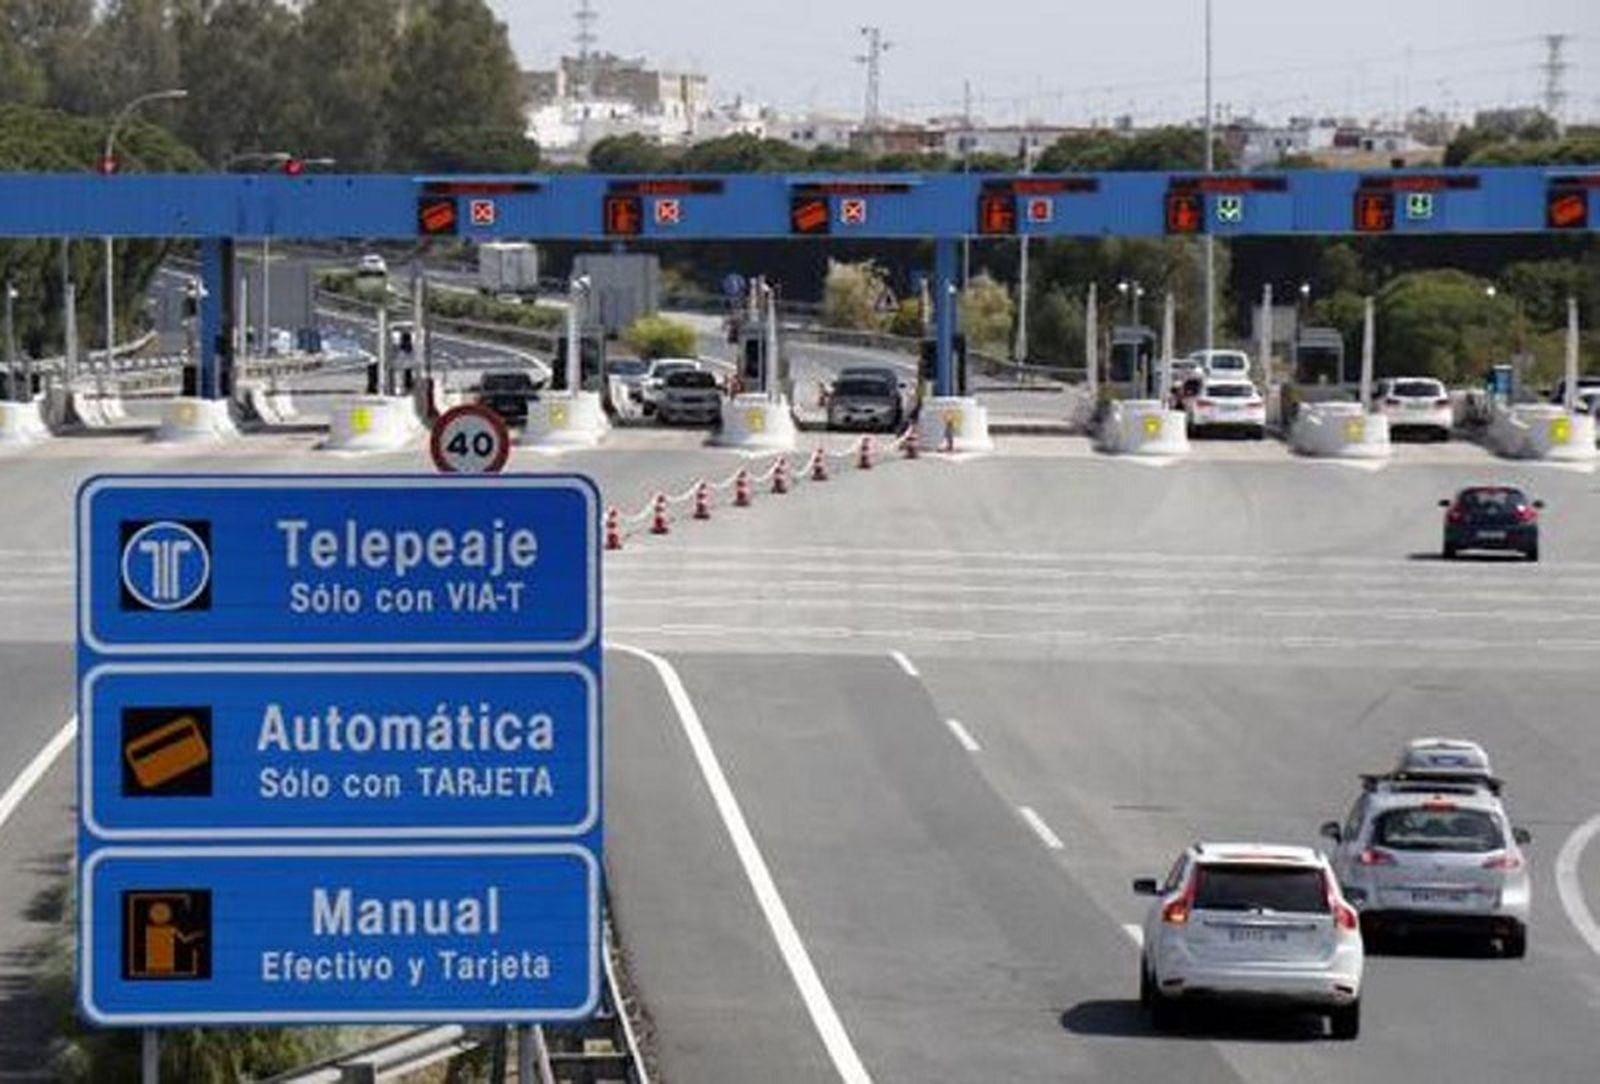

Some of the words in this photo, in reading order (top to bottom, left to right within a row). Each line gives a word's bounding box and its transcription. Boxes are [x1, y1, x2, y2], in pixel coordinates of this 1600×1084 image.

[446, 430, 494, 459] 40
[279, 520, 538, 576] Telepeaje
[291, 582, 361, 613] Sólo
[376, 589, 433, 612] con
[448, 582, 524, 611] VIA-T
[257, 702, 555, 752] Automática
[260, 767, 330, 798] Sólo
[343, 774, 400, 797] con
[417, 766, 554, 796] TARJETA
[312, 887, 499, 936] Manual
[262, 951, 393, 981] Efectivo
[408, 956, 424, 986] y
[439, 951, 551, 984] Tarjeta
